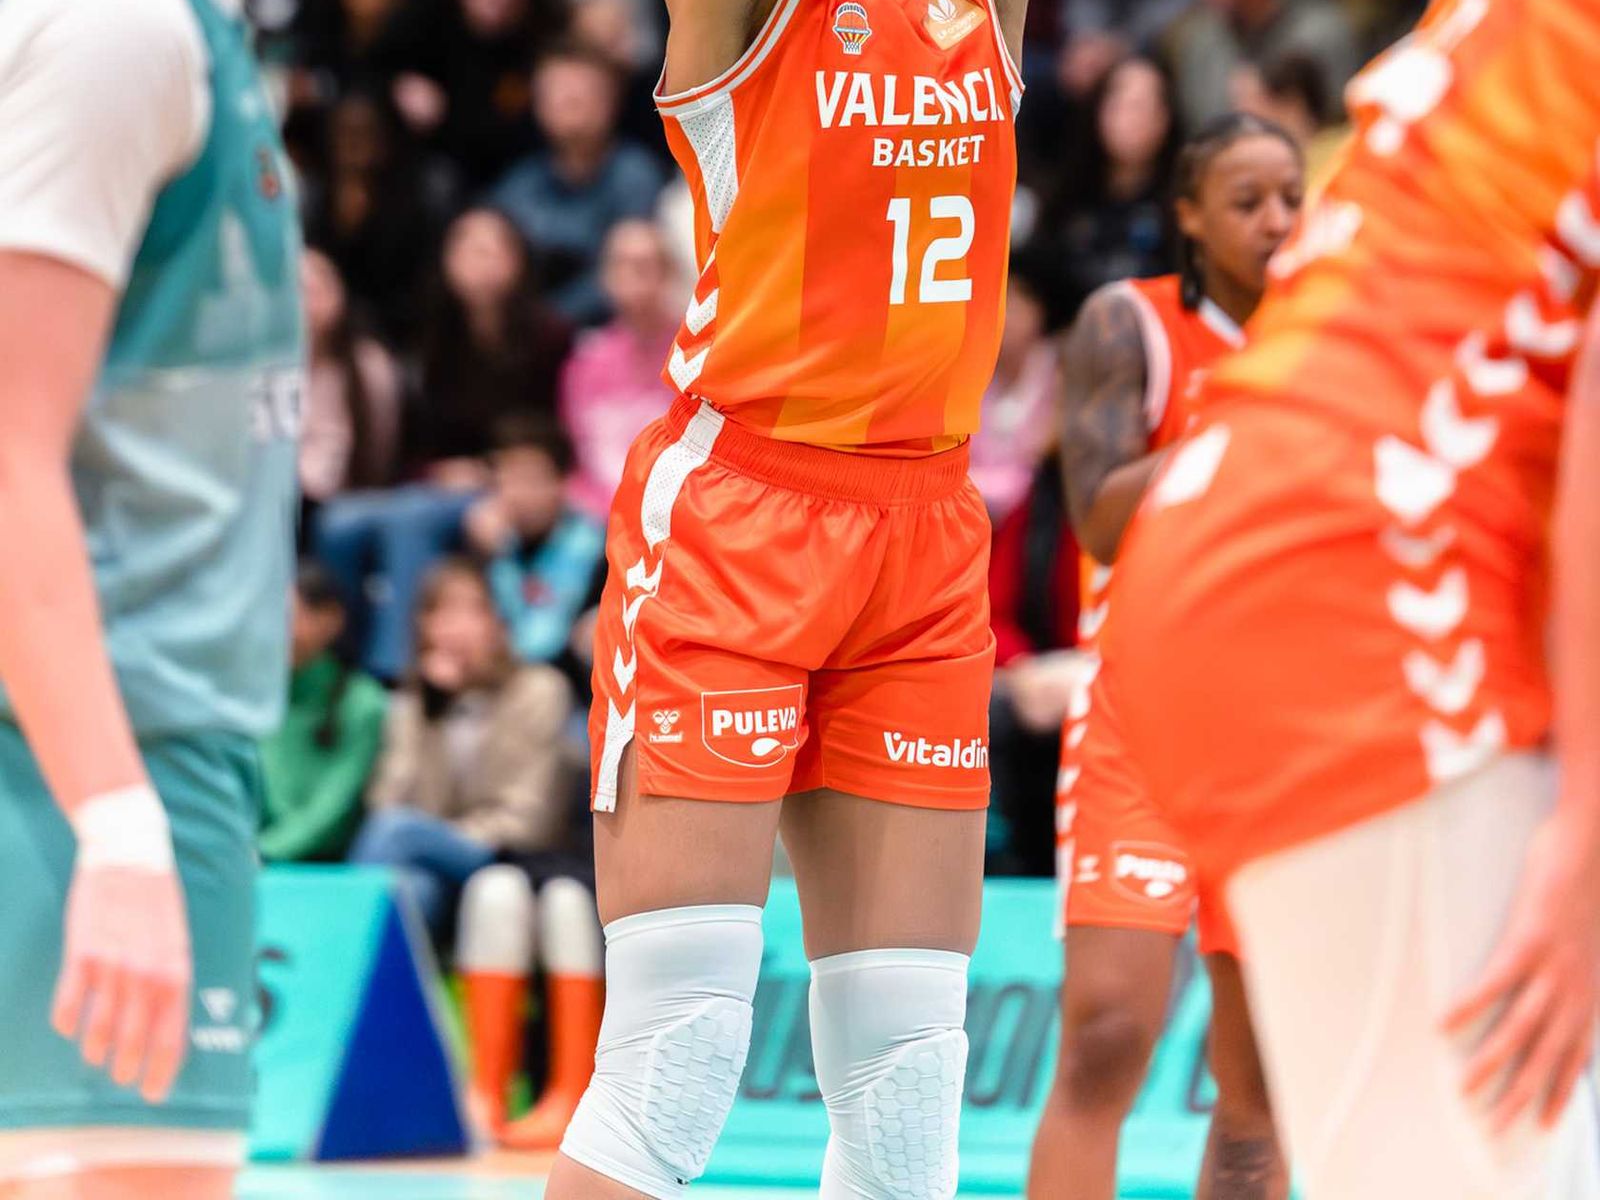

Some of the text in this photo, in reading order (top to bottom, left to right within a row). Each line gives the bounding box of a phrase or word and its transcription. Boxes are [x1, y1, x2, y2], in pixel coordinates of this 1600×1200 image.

[815, 68, 1005, 128] VALENCI
[872, 135, 985, 167] BASKET
[886, 196, 976, 304] 12
[711, 707, 797, 736] PULEVA
[883, 731, 988, 768] Vitaldin
